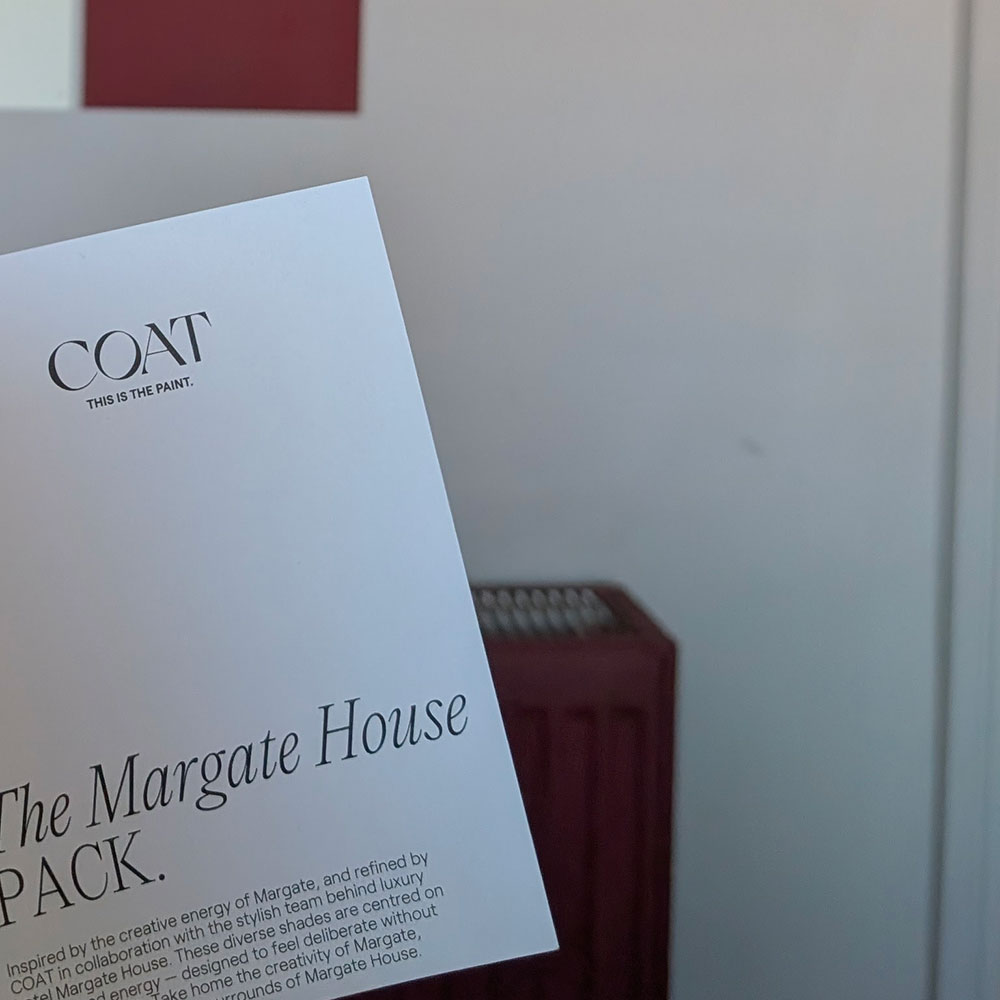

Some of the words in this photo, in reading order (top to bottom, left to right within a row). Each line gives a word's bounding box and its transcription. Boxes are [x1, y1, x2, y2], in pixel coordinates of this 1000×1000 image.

[48, 312, 212, 391] COAT
[86, 395, 114, 409] THIS
[116, 392, 128, 402] IS
[129, 385, 154, 399] THE
[156, 377, 193, 394] PAINT.
[86, 730, 300, 828] Margate
[315, 694, 468, 767] House
[7, 946, 66, 977] Inspired
[69, 943, 86, 958] by
[90, 935, 115, 950] the
[119, 917, 177, 942] creative
[181, 902, 230, 924] energy
[235, 893, 250, 909] of
[254, 880, 319, 904] Margate,
[323, 867, 351, 886] and
[355, 854, 407, 878] refined
[410, 852, 428, 867] by
[11, 968, 53, 994] COAT
[58, 967, 71, 980] in
[75, 938, 170, 974] collaboration
[174, 926, 204, 944] with
[208, 920, 232, 934] the
[236, 905, 281, 927] stylish
[284, 896, 322, 914] team
[326, 880, 377, 904] behind
[380, 872, 423, 891] luxury
[15, 989, 52, 1000] tel
[56, 972, 118, 1000] Margate
[121, 957, 172, 980] House.
[174, 942, 219, 962] These
[224, 927, 275, 949] diverse
[279, 912, 331, 934] shades
[335, 906, 359, 920] are
[363, 888, 421, 913] centred
[425, 886, 444, 899] on
[110, 978, 160, 1000] energy
[182, 950, 248, 980] designed
[252, 948, 268, 960] to
[272, 936, 299, 955] feel
[304, 920, 378, 946] deliberate
[380, 904, 438, 927] without
[190, 976, 233, 997] home
[236, 968, 261, 983] the
[265, 949, 330, 976] creativity
[335, 941, 349, 957] of
[354, 929, 421, 952] Margate,
[216, 980, 282, 1000] rounds
[286, 972, 300, 988] of
[305, 959, 367, 984] Margate
[370, 948, 421, 967] House.
